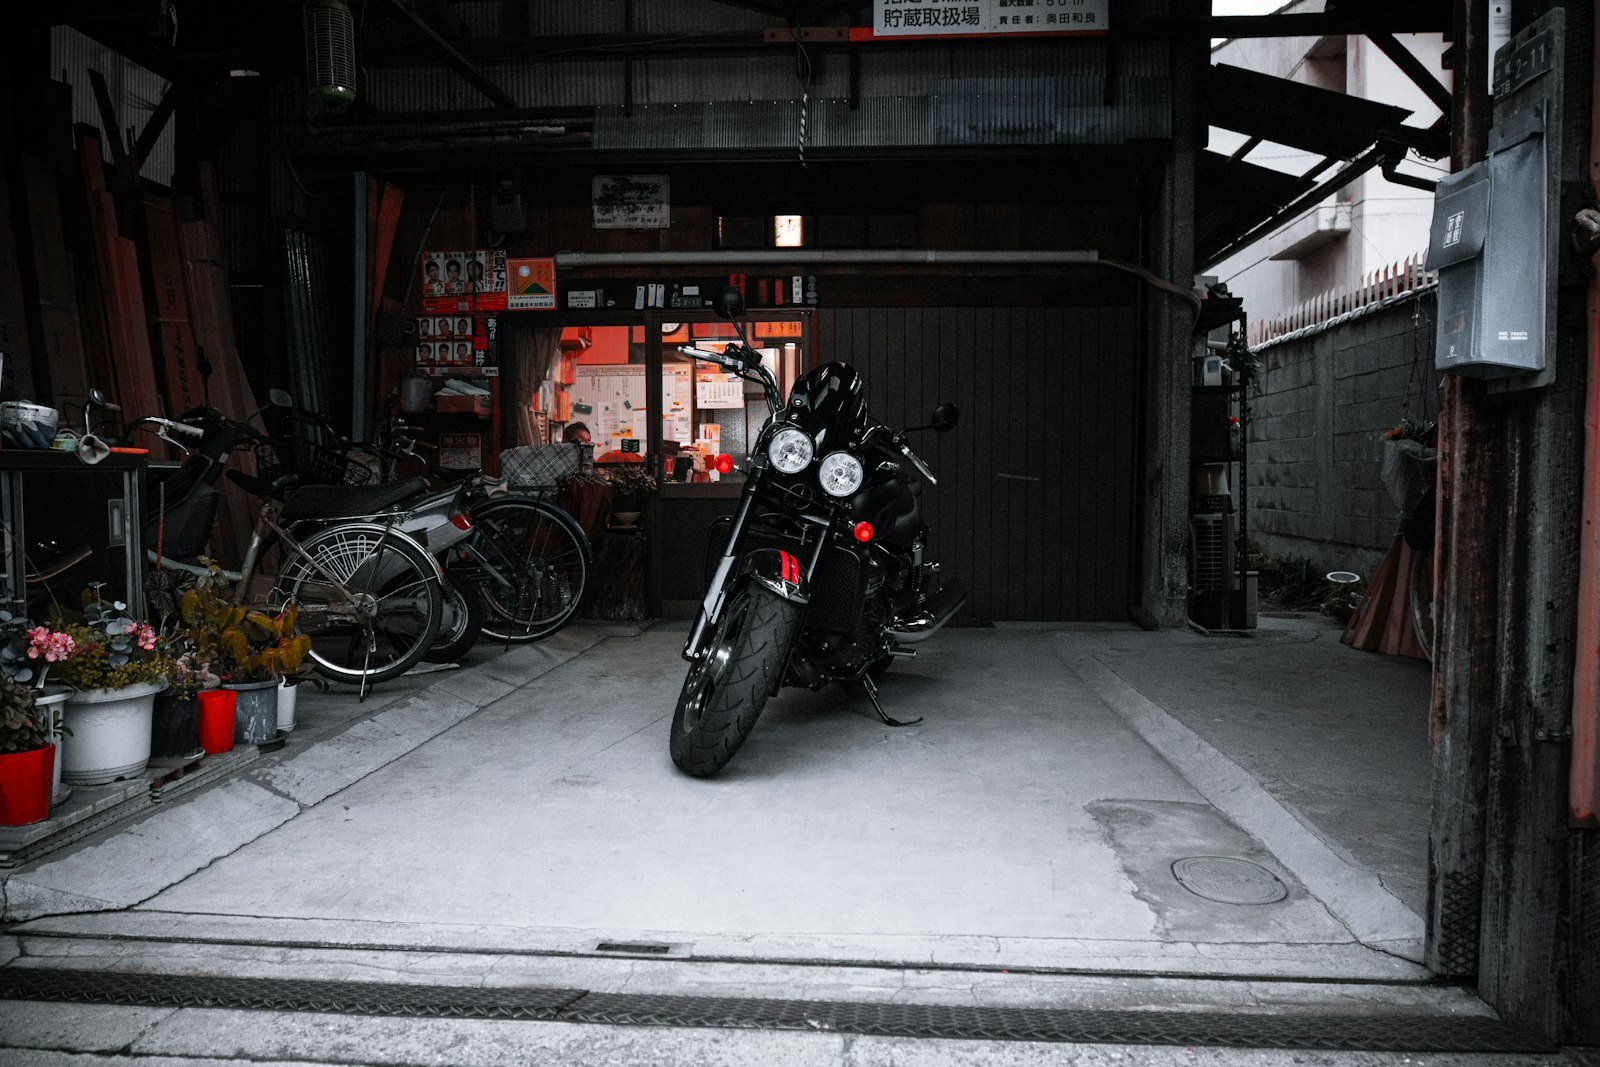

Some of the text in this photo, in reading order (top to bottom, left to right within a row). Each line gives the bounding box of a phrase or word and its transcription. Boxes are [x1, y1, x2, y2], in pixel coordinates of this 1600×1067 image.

[884, 6, 980, 28] 貯蔵取扱場
[1515, 43, 1545, 79] 2-11
